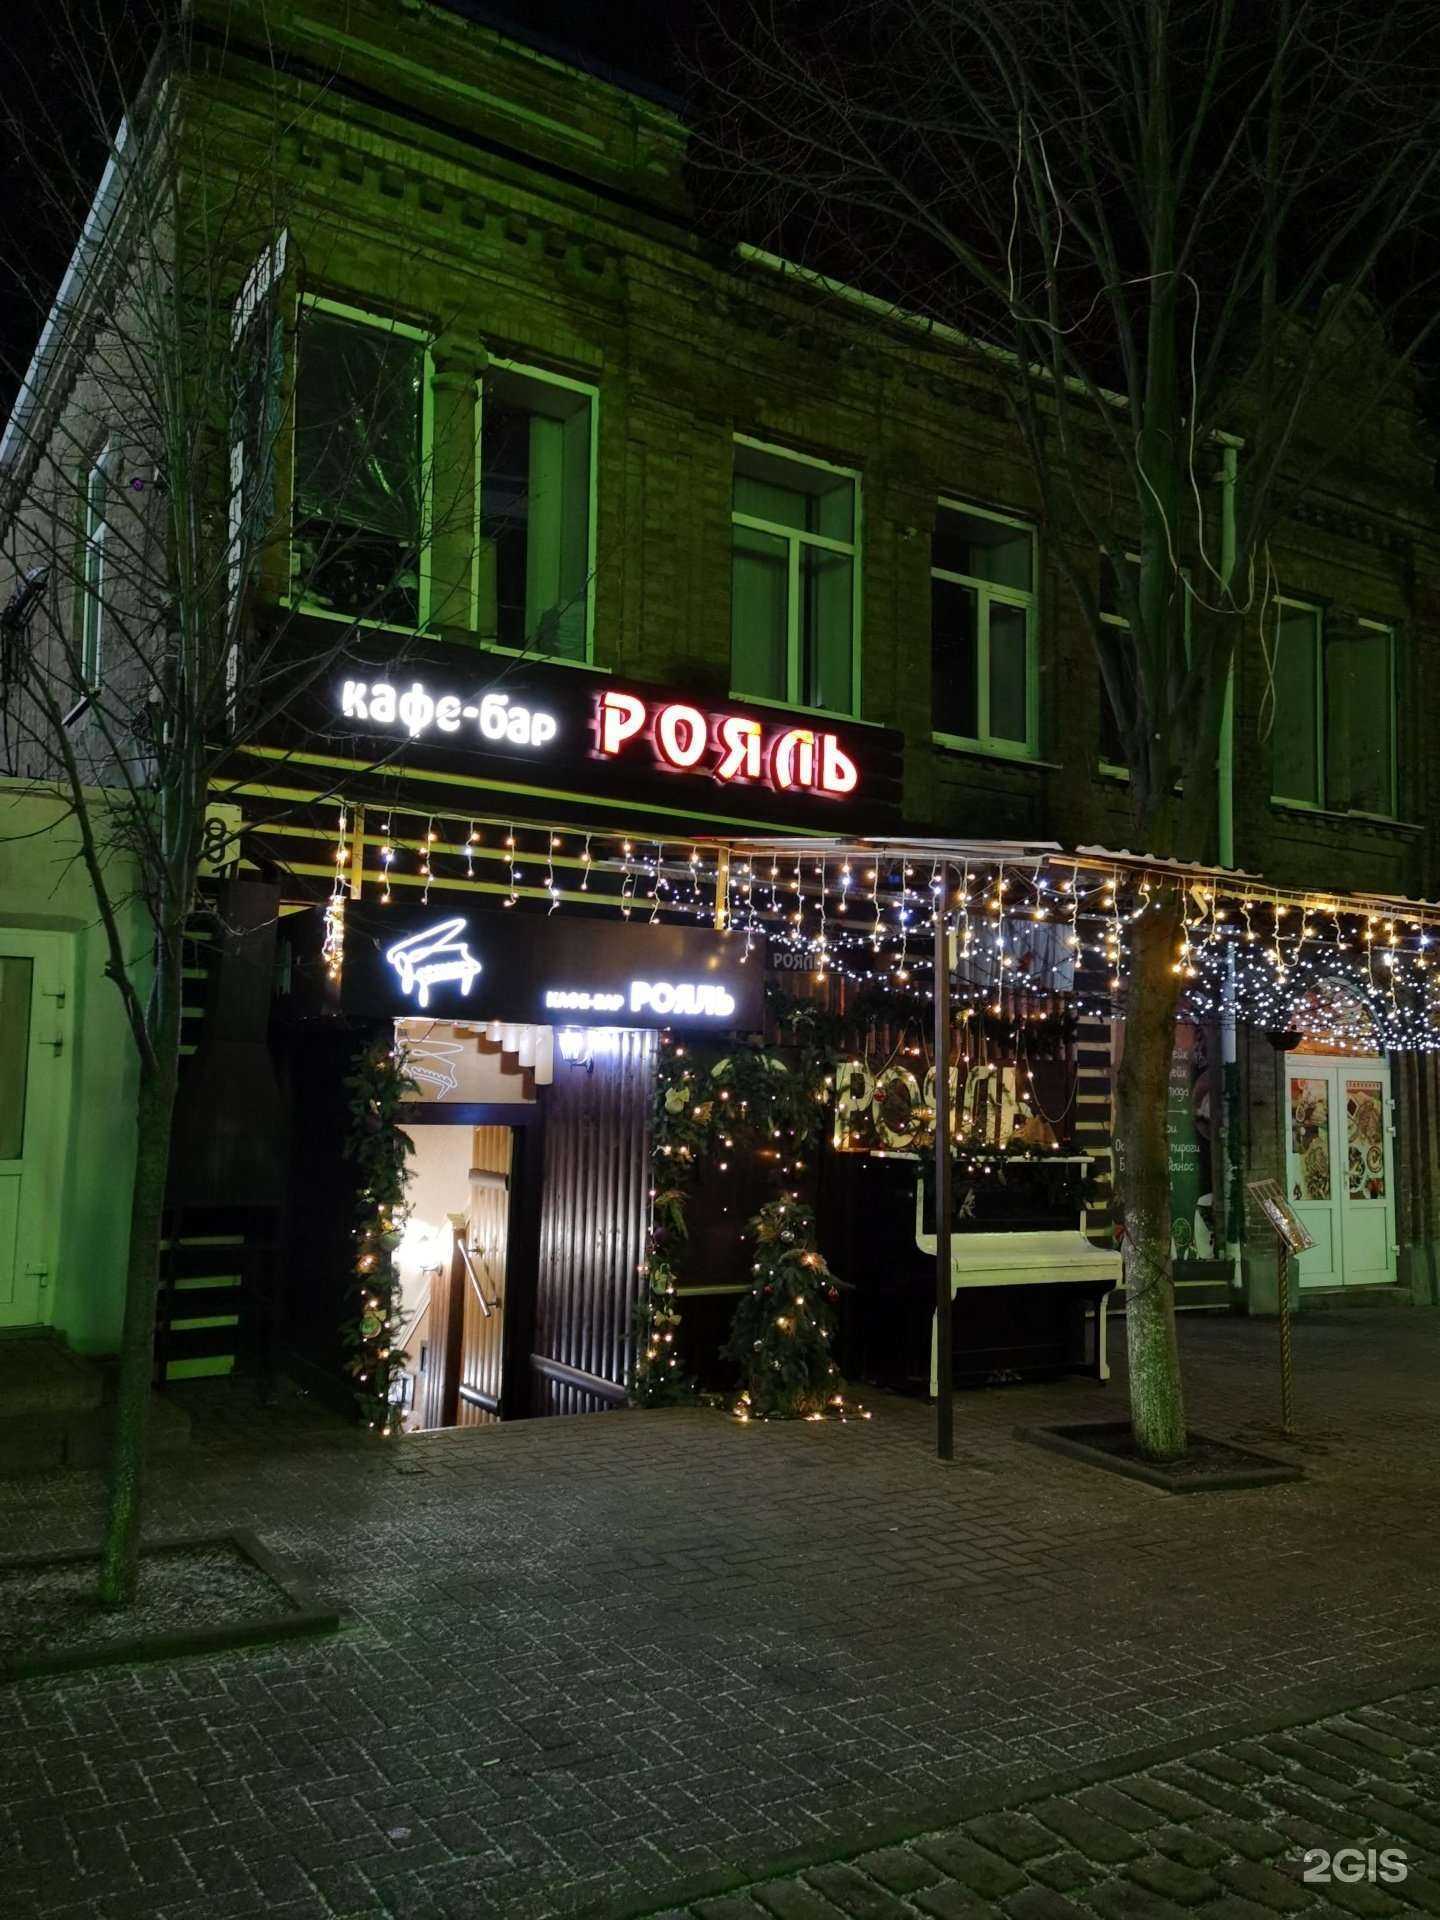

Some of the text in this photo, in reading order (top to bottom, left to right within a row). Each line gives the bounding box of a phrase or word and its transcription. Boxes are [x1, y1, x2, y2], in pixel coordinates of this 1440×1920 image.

[341, 679, 863, 795] кафе-бар РОЯЛЬ
[630, 981, 735, 1017] РОЯЛЬ
